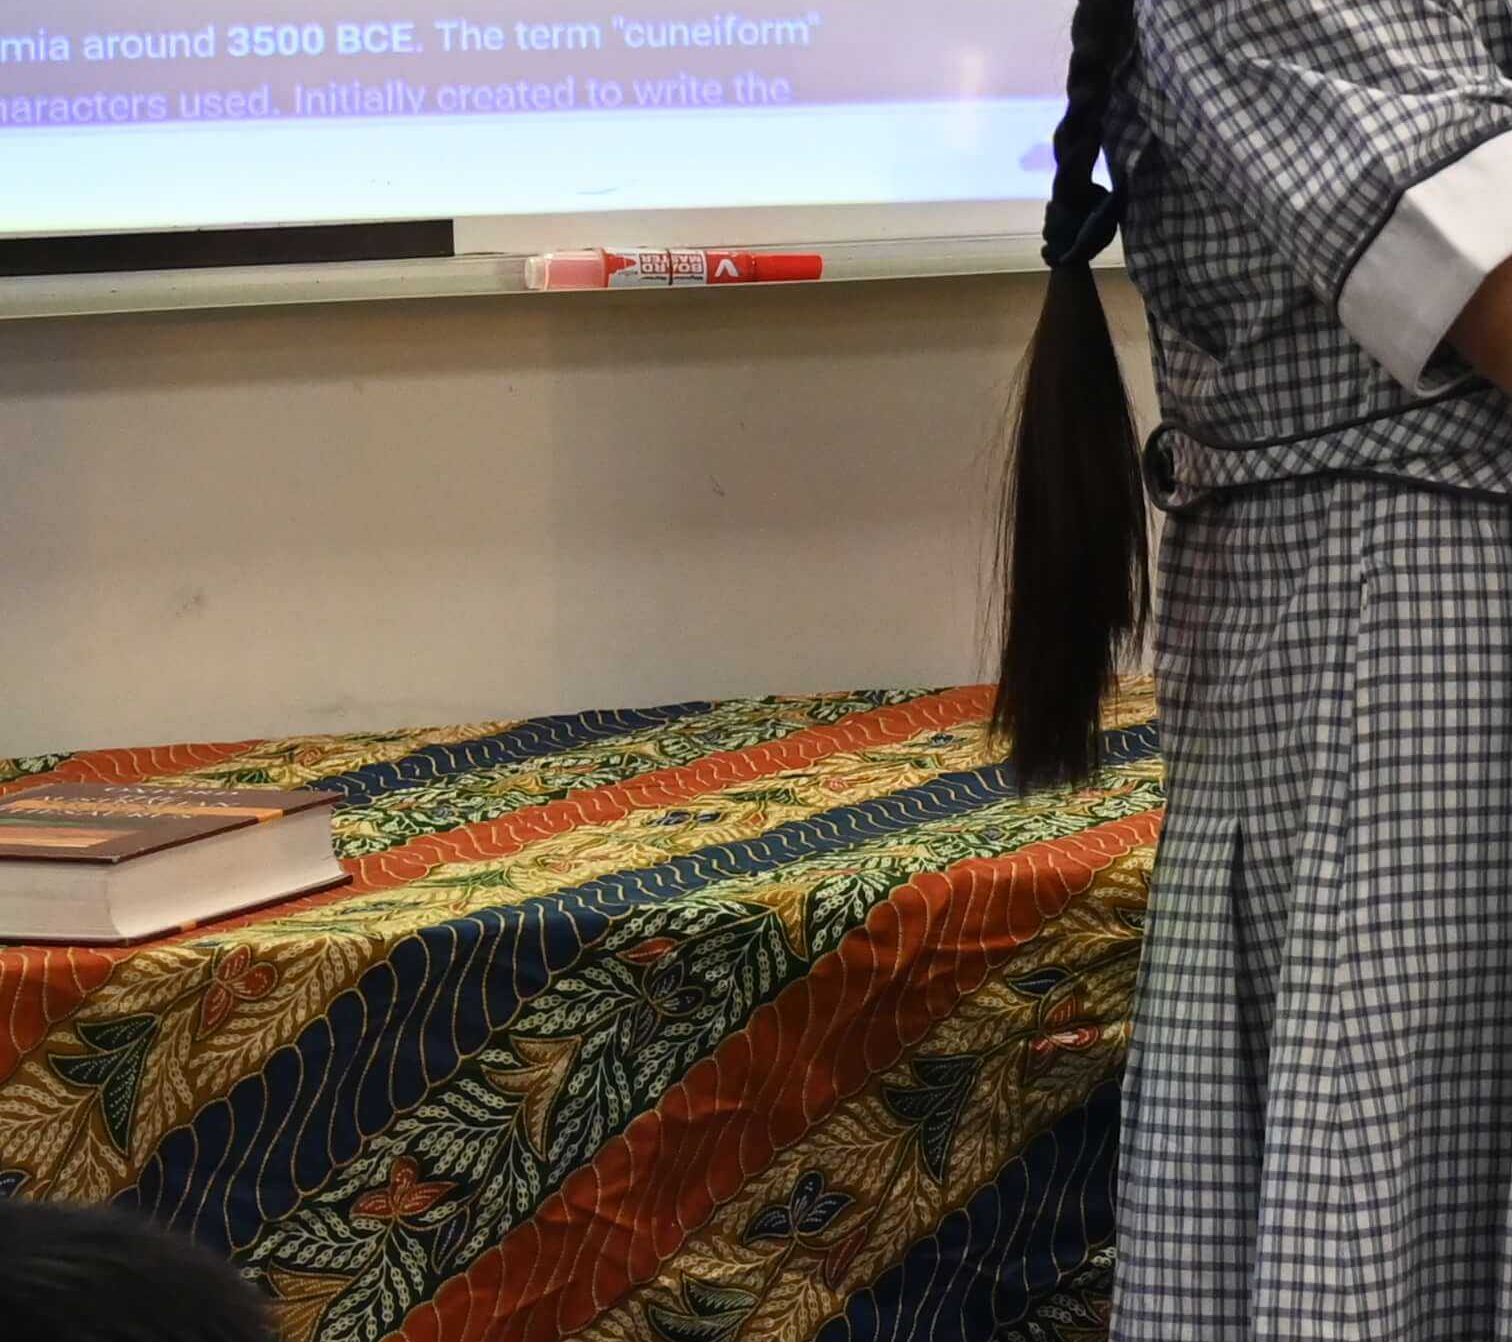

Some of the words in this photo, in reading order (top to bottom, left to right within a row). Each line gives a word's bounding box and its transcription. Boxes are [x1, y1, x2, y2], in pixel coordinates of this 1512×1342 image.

[0, 26, 71, 62] mia
[82, 25, 215, 60] around
[226, 22, 326, 58] 3500
[336, 21, 422, 55] BCE.
[434, 16, 505, 51] The
[514, 21, 600, 51] term
[612, 10, 823, 49] "cuneiform"
[179, 82, 281, 119] used.
[295, 75, 425, 118] Initially
[436, 74, 576, 115] created
[586, 76, 623, 109] to
[631, 70, 724, 107] write
[734, 68, 793, 105] the
